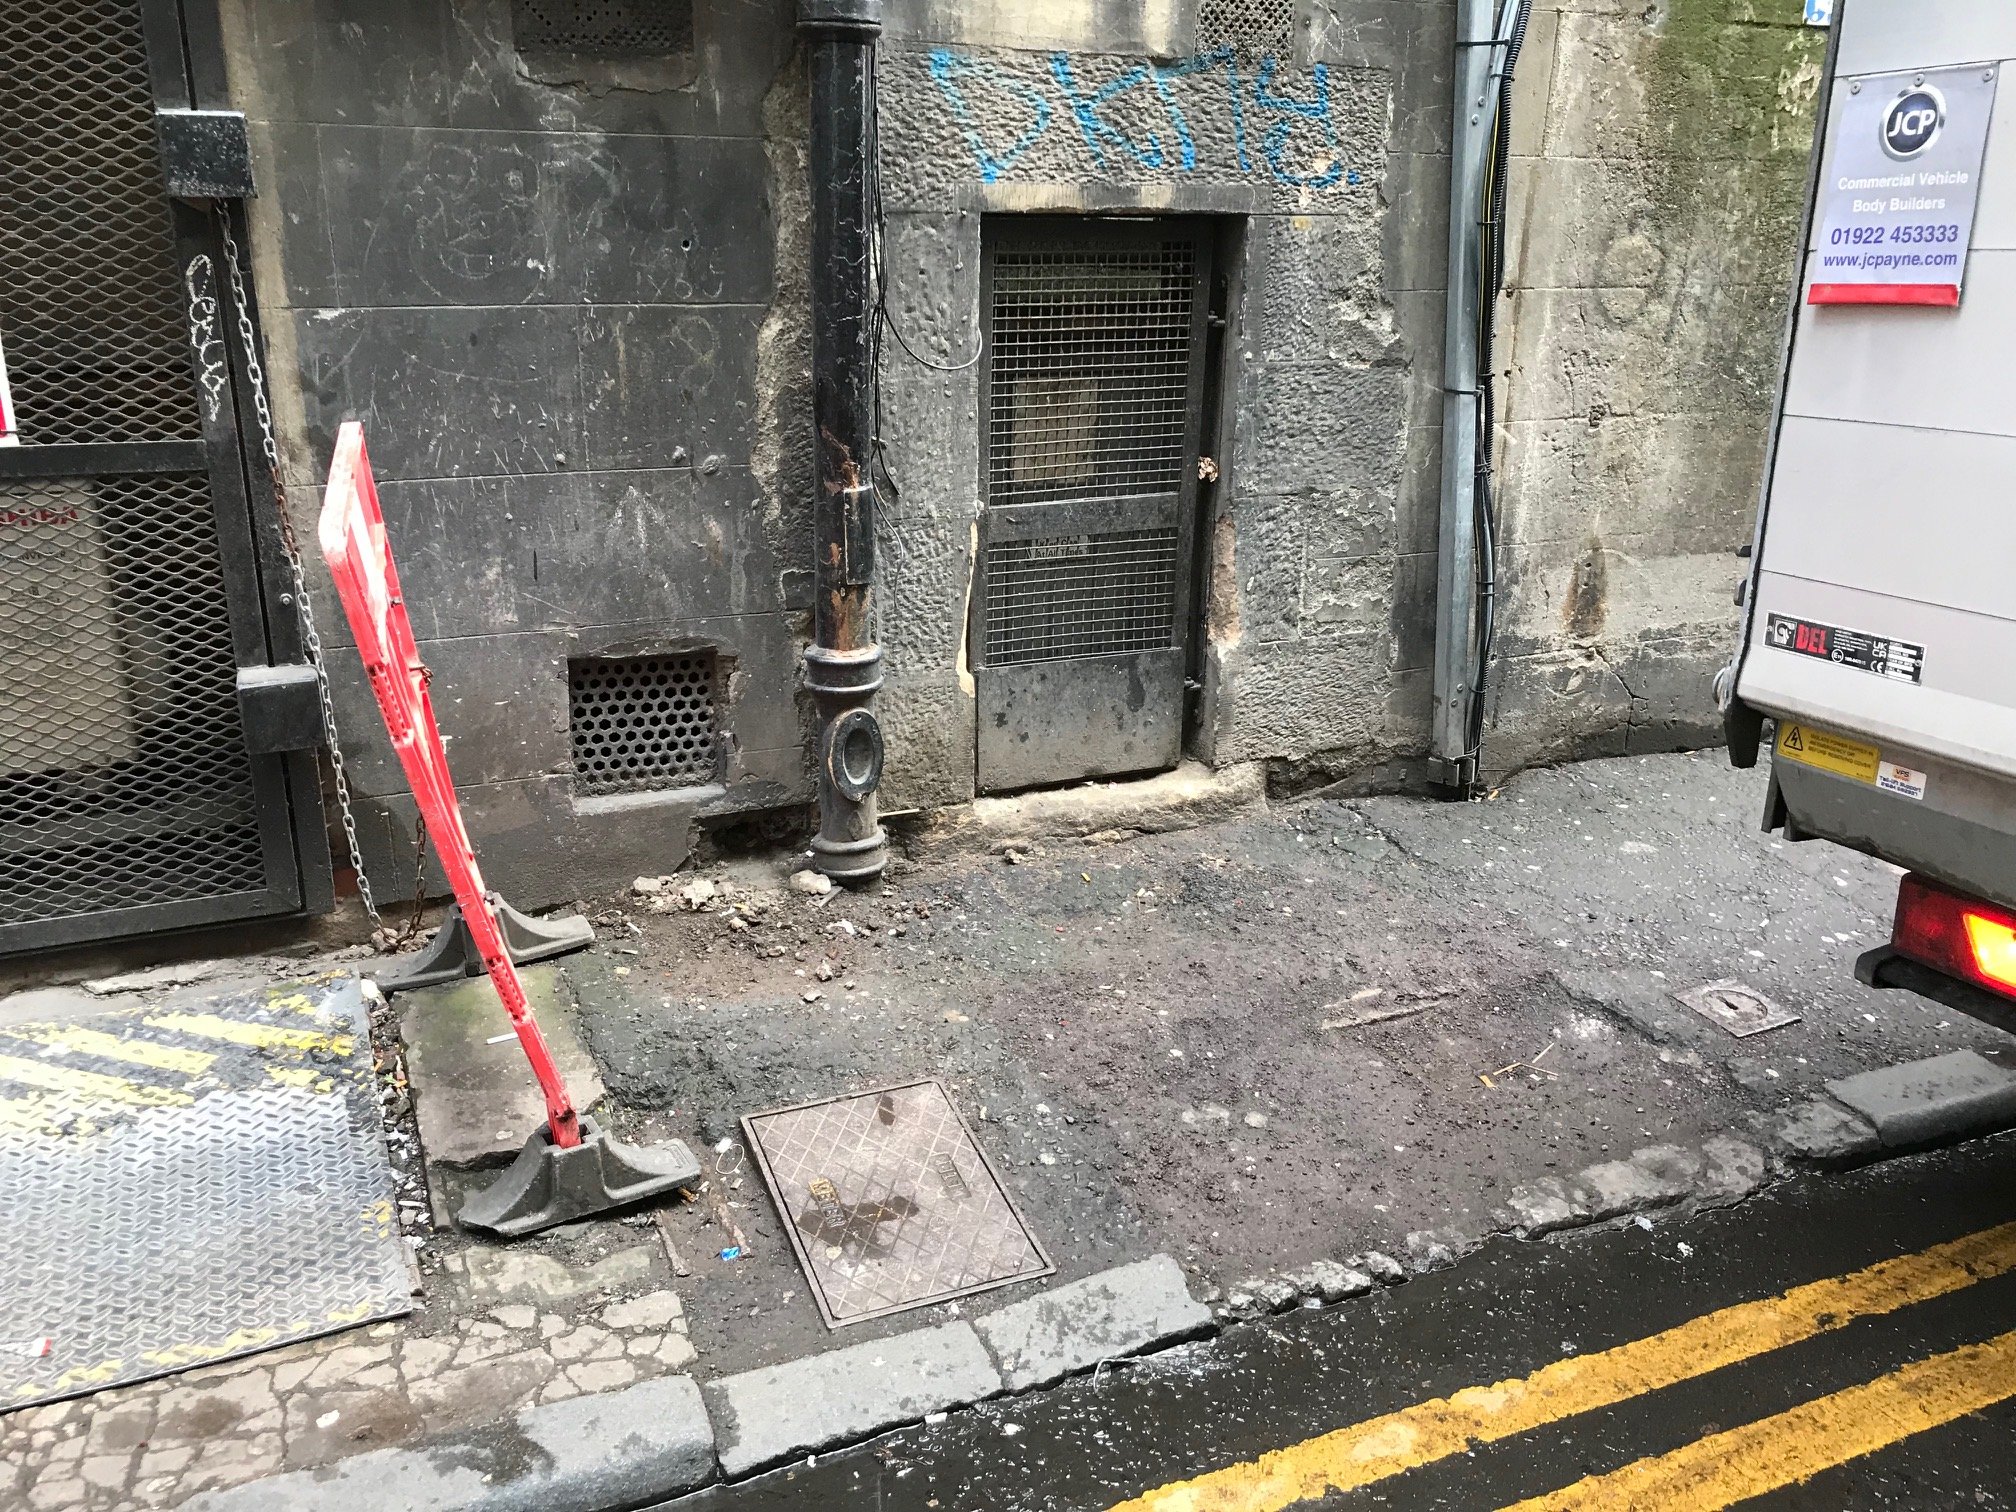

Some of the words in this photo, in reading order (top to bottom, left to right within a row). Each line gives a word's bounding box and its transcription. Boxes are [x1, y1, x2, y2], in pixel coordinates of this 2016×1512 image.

[1888, 109, 1936, 137] JCP
[1838, 174, 1915, 191] Commercial
[1919, 170, 1969, 186] Vehicle
[1852, 198, 1886, 215] Body
[1890, 197, 1946, 211] Builders
[1831, 226, 1885, 245] 01922
[1890, 224, 1959, 243] 453333
[1823, 252, 1958, 270] www.jcpayne.com
[1796, 623, 1828, 655] DEL
[1873, 640, 1887, 651] UK
[1871, 649, 1887, 659] CA
[1870, 660, 1884, 674] CE
